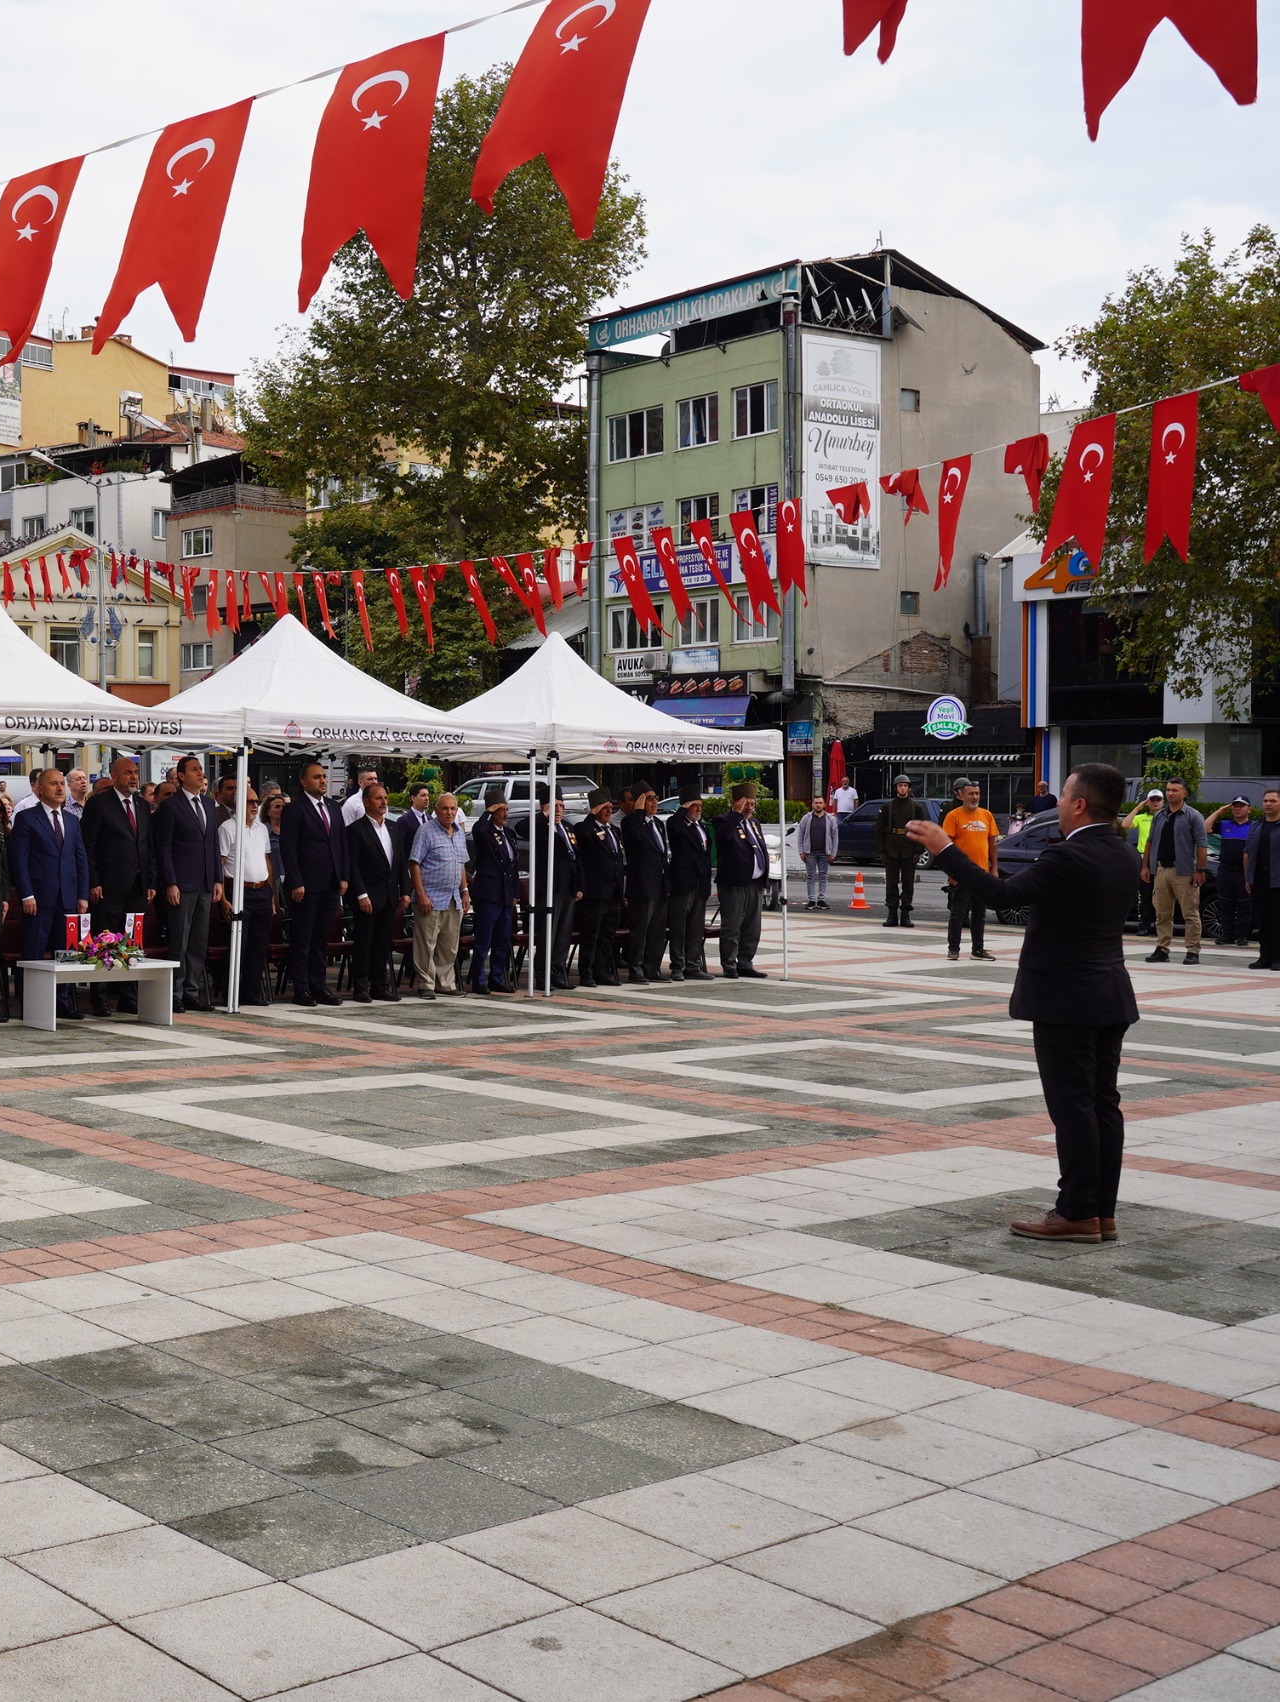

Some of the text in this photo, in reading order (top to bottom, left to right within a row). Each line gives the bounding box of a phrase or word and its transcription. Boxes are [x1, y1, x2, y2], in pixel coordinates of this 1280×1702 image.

[615, 305, 675, 340] ORHANGAZİ
[677, 295, 706, 324] ÜLKÜ
[813, 384, 846, 394] ÇAMLICA
[820, 398, 864, 413] ORTAOKUL
[808, 411, 875, 428] ANADOLU LİSESİ
[808, 427, 874, 460] Umurbey
[839, 465, 866, 474] TELEFONU
[815, 473, 833, 483] 0549
[835, 475, 848, 484] 650
[617, 657, 643, 671] AVUKA
[4, 715, 183, 735] ORHANGAZİ BELEDİYESİ
[932, 722, 959, 731] EMLAK
[312, 727, 466, 745] ORHANGAZİ BELEDİYESİ
[625, 740, 744, 755] ORHANGAZİ BELEDİYESİ
